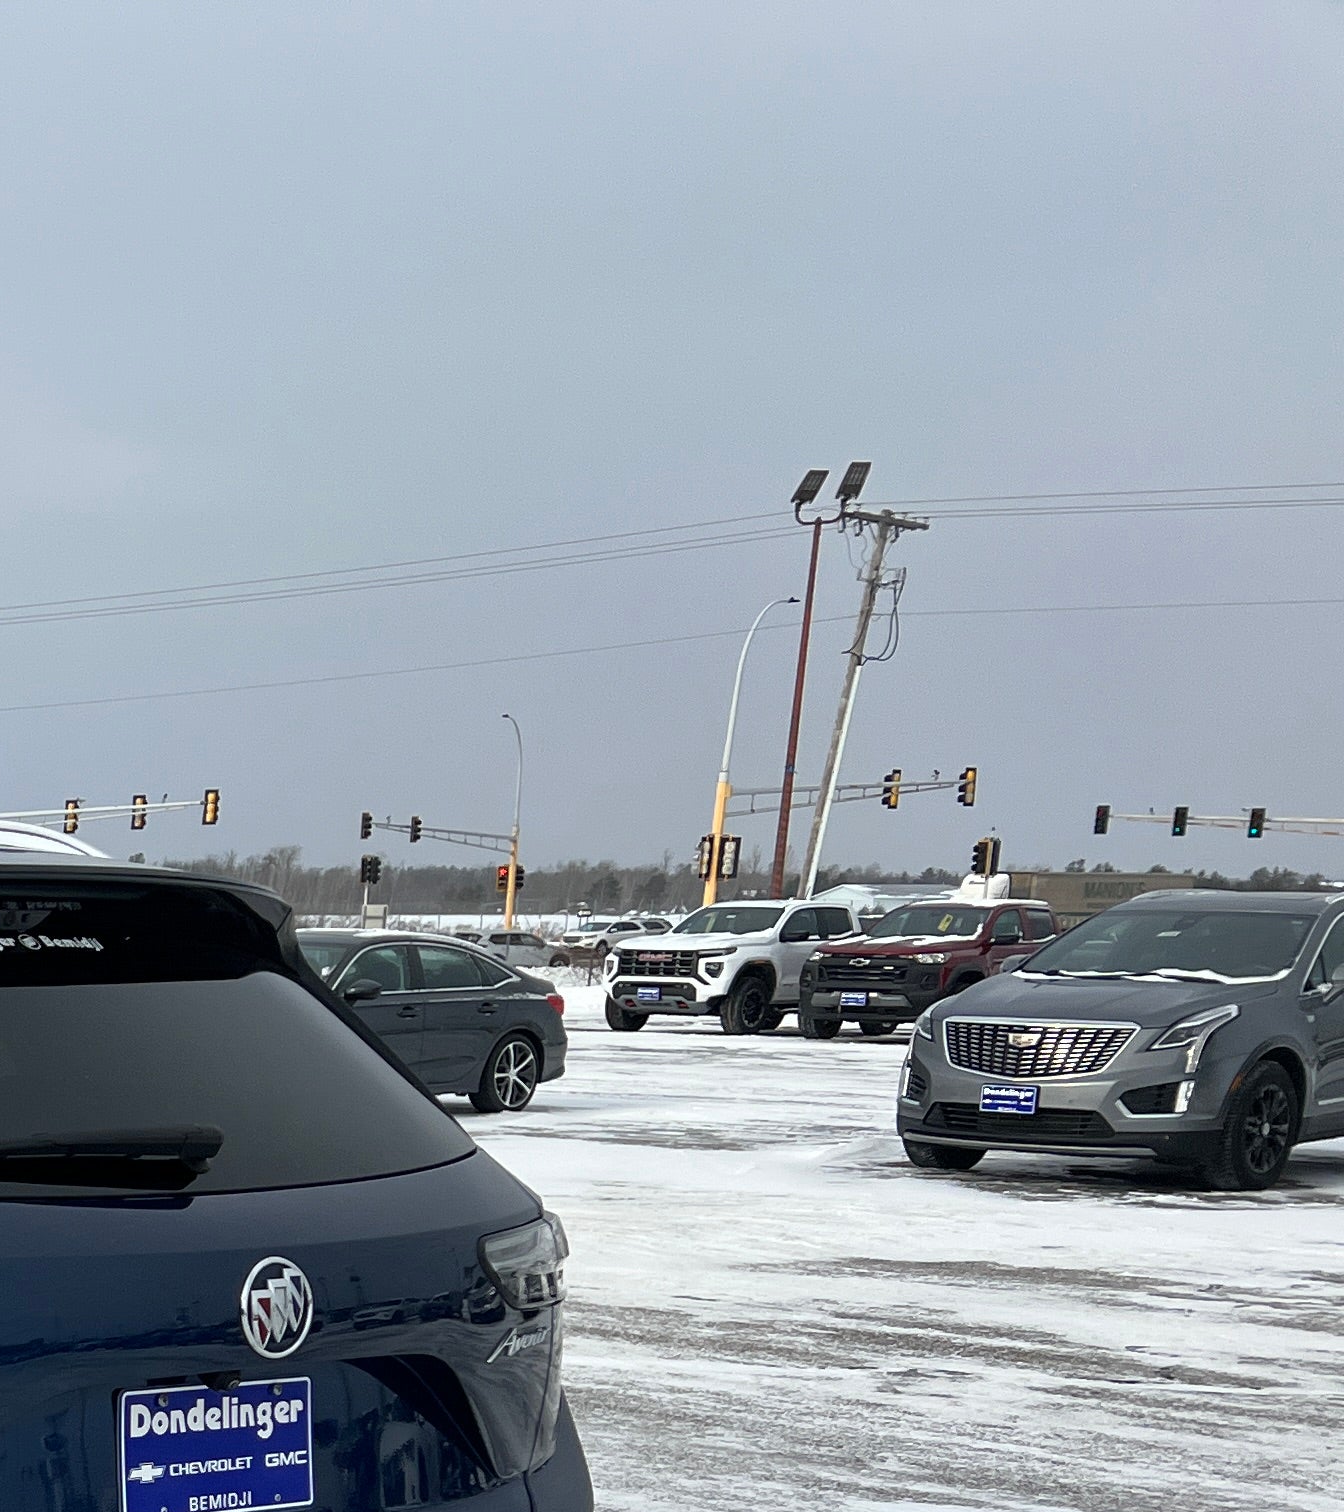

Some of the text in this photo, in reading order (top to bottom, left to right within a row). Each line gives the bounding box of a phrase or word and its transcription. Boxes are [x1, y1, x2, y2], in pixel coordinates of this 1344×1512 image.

[130, 1396, 304, 1439] Dondelinger
[169, 1450, 308, 1477] CHEVROLET GMC
[189, 1491, 252, 1512] BEMIDJI
